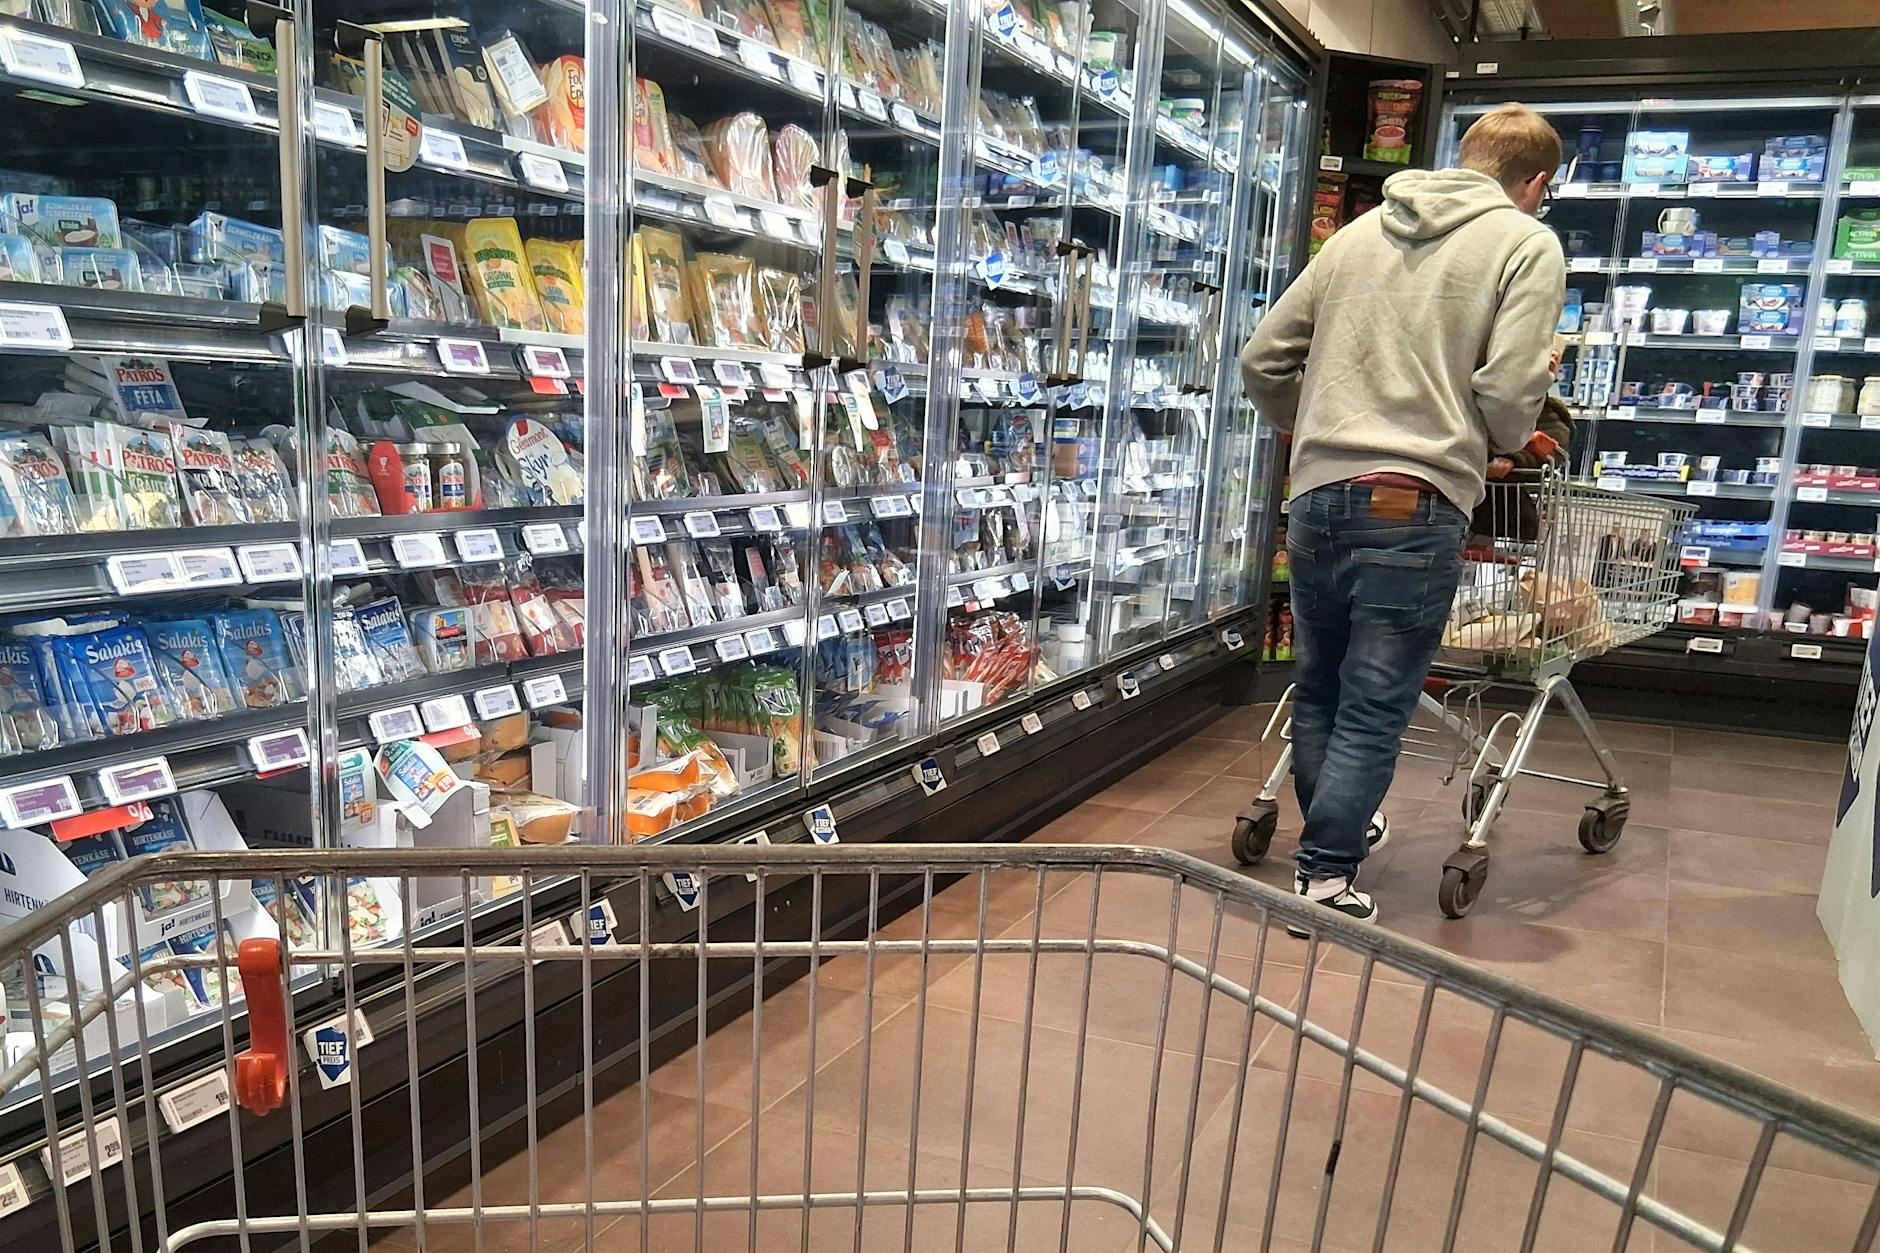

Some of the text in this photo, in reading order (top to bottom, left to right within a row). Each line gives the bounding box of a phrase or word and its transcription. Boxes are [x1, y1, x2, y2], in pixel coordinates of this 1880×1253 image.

[16, 199, 35, 222] ja!
[115, 367, 165, 382] PATROS
[133, 389, 165, 405] FETA
[122, 449, 175, 474] PATROS
[182, 448, 232, 469] PATROS
[518, 453, 550, 480] Skyr
[158, 630, 209, 650] Salakis
[225, 620, 273, 641] Salakis
[86, 637, 145, 665] Salakis
[128, 802, 154, 821] %
[133, 828, 176, 846] HIRTENKÄSE
[72, 849, 111, 865] TENKÄSE
[676, 878, 692, 888] TIEF
[4, 887, 46, 911] HIRTENK
[161, 917, 176, 937] ja!
[591, 919, 605, 930] IEF
[318, 1041, 345, 1055] TIEF
[105, 1140, 120, 1158] 2.99
